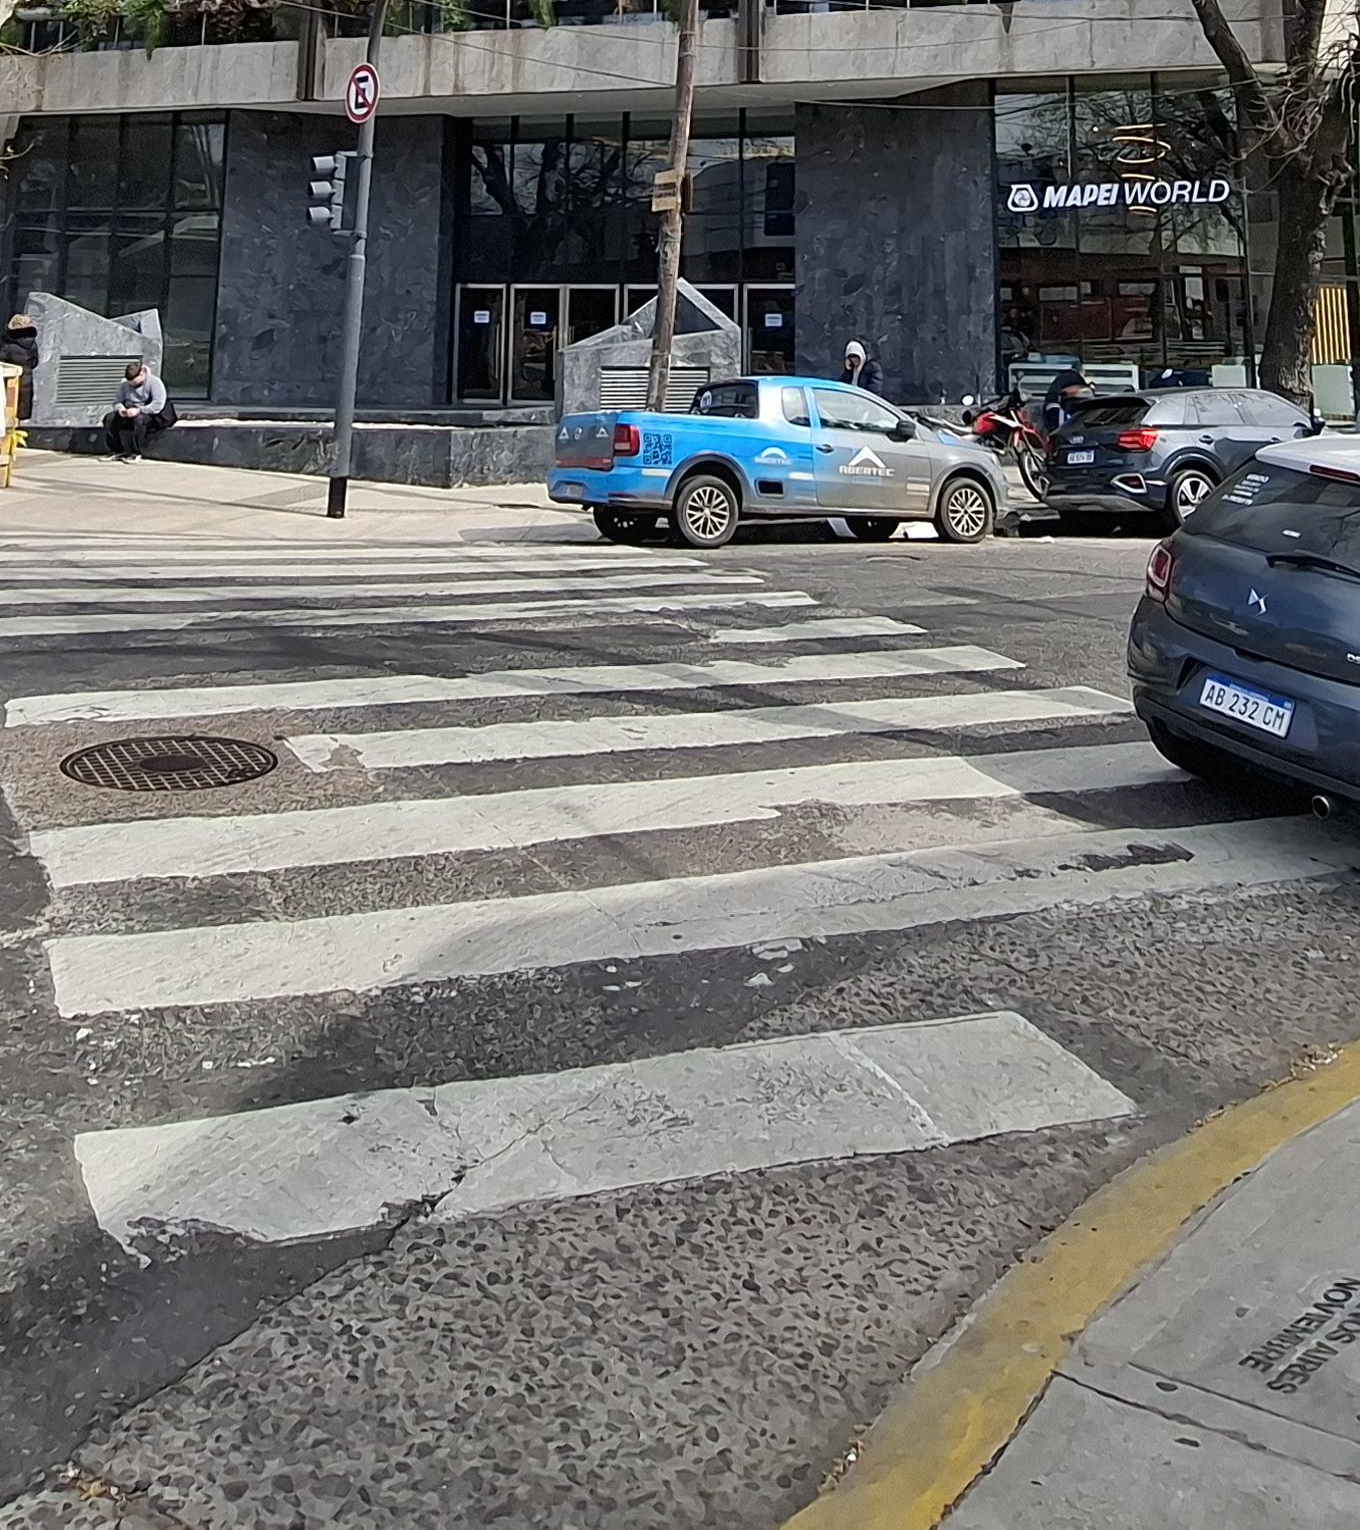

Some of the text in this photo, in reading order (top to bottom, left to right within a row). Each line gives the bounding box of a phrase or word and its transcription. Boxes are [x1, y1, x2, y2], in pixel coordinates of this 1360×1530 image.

[1043, 180, 1230, 208] MAPEI WORLD
[1204, 684, 1227, 707] AB
[1228, 692, 1260, 721] 232
[1261, 705, 1286, 731] CM
[1266, 1341, 1339, 1394] AIRES
